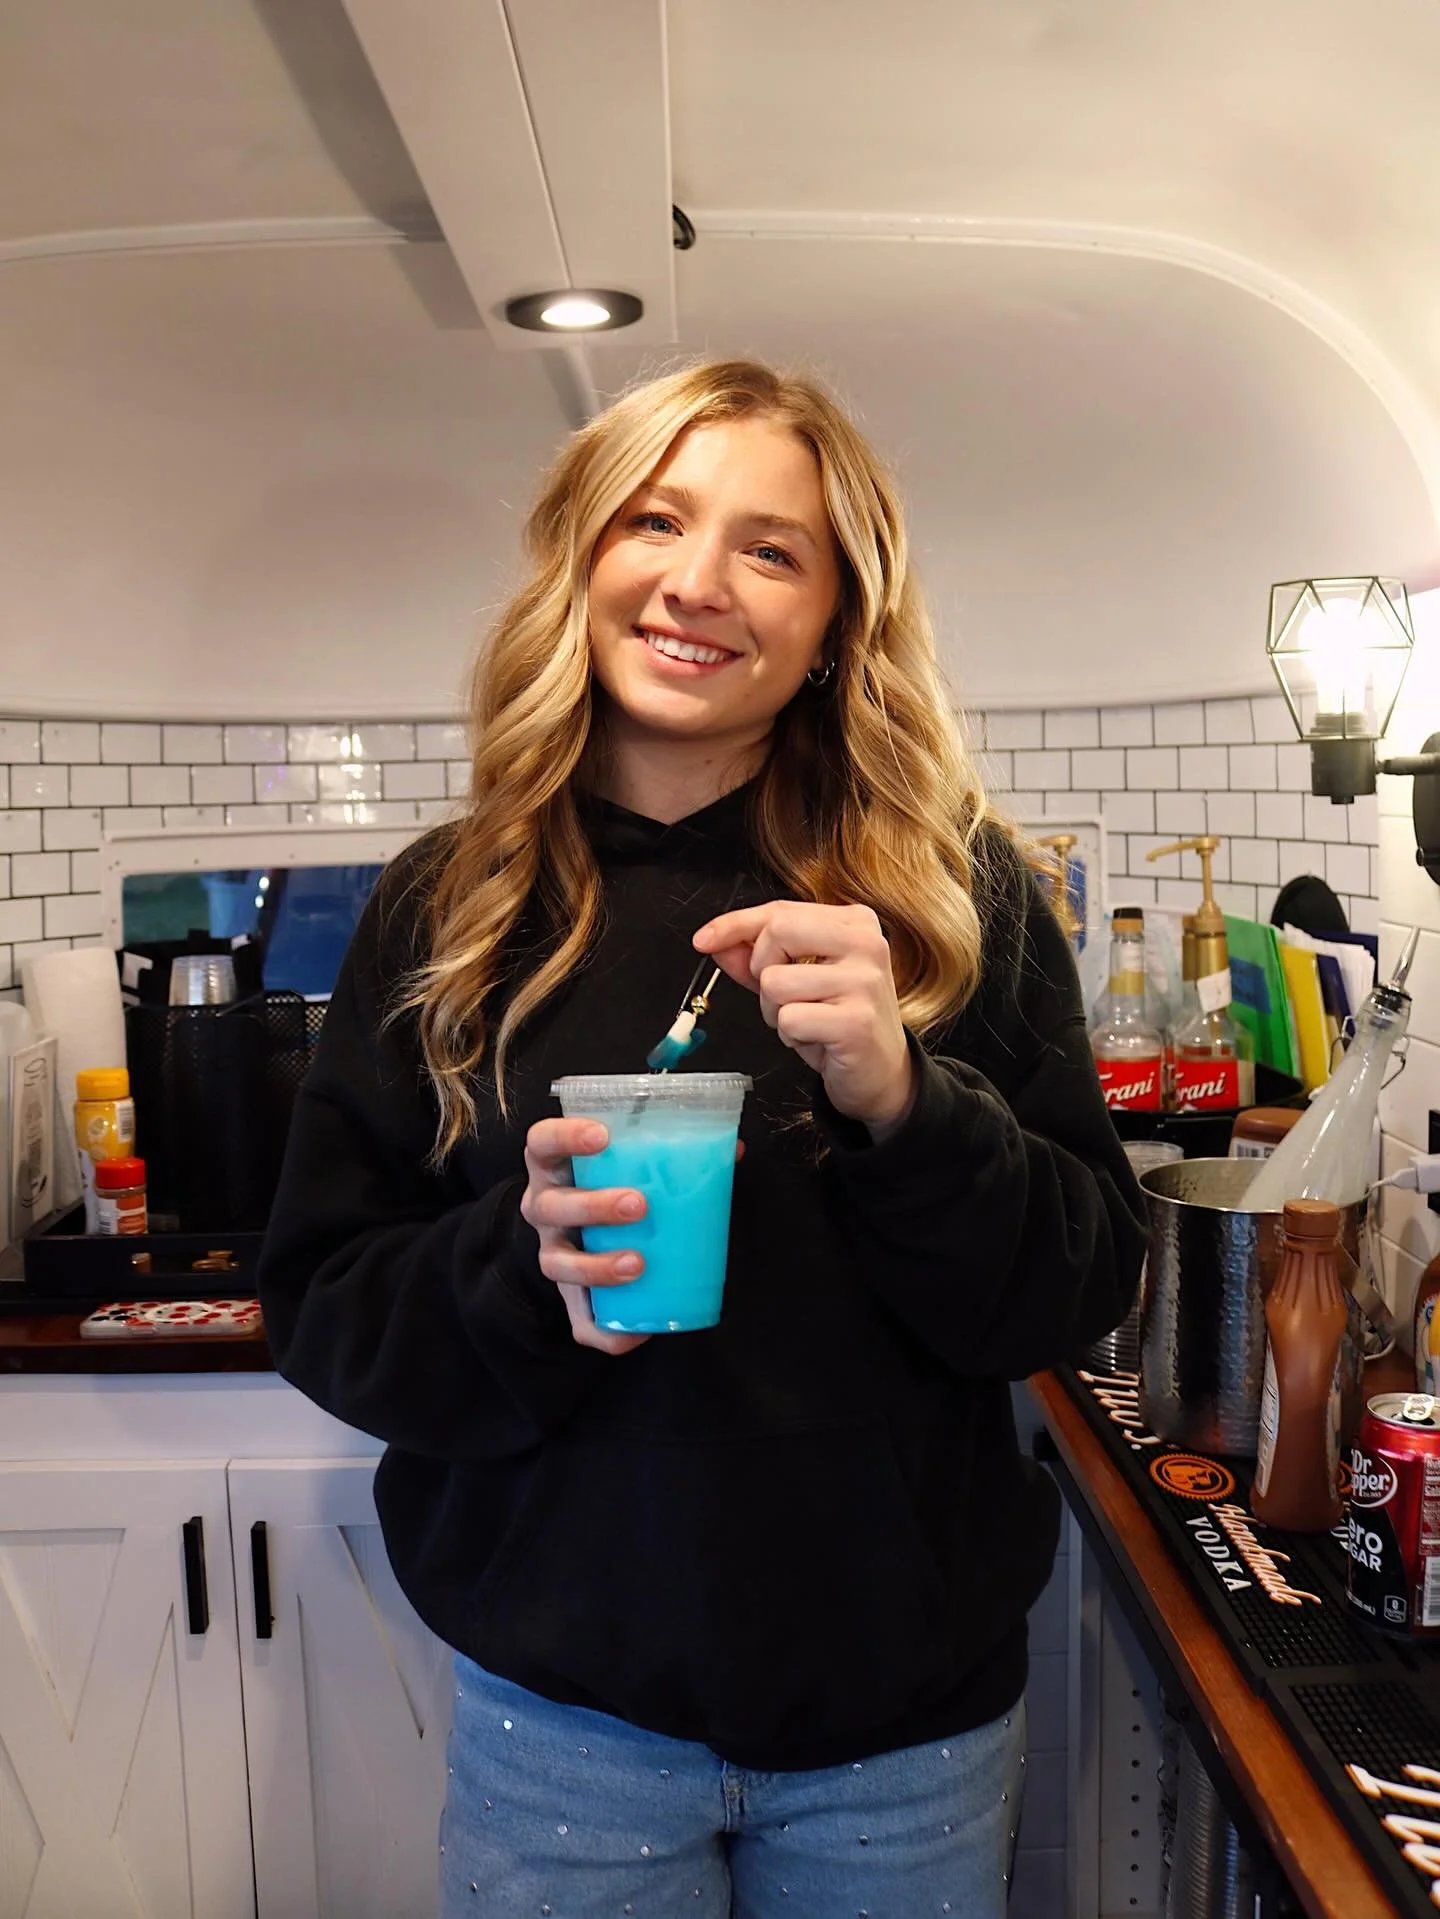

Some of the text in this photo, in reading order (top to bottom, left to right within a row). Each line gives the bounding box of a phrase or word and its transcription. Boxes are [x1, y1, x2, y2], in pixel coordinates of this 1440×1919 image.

[1100, 1072, 1155, 1103] rani
[1175, 1072, 1227, 1101] rani
[1351, 1448, 1373, 1474] Dr
[1351, 1473, 1391, 1497] pper
[1348, 1517, 1384, 1554] ero
[1185, 1516, 1253, 1593] VODKA
[1208, 1503, 1322, 1606] Handmade
[1349, 1543, 1382, 1573] GAR
